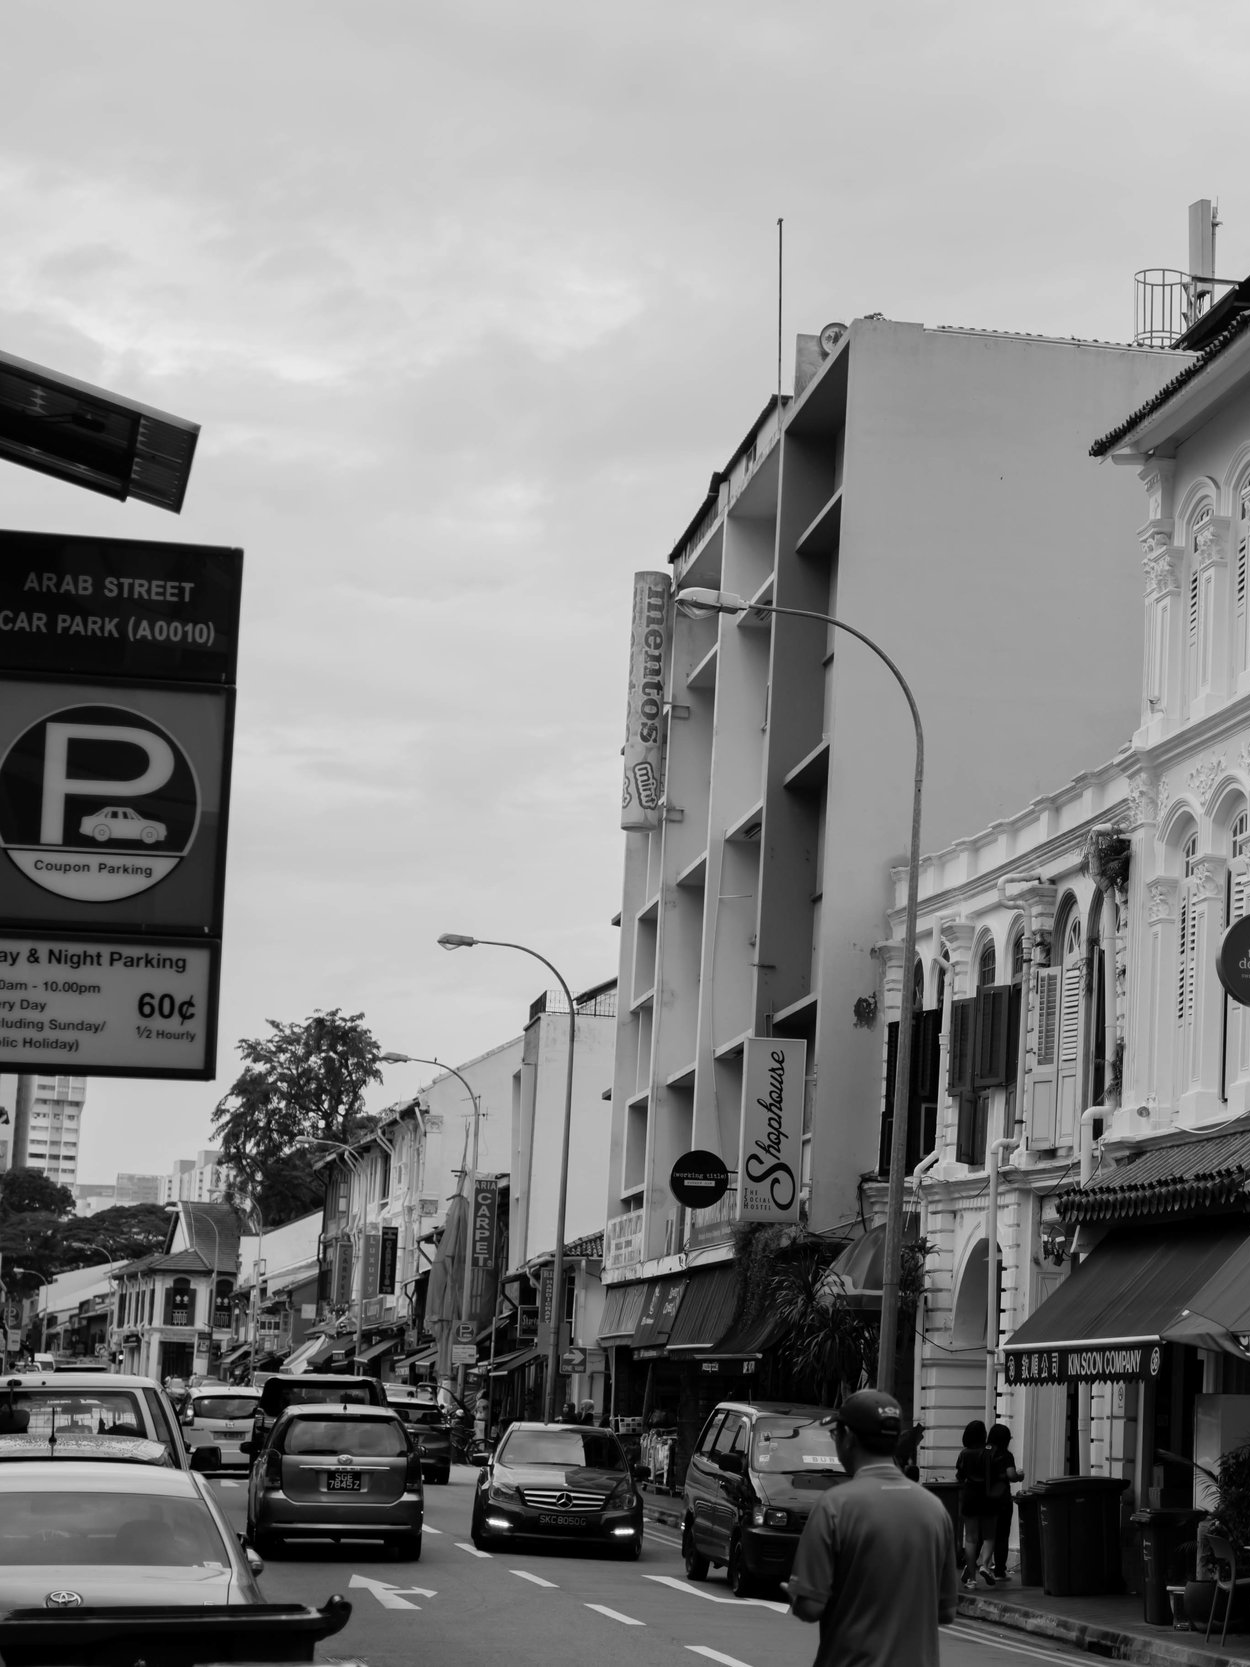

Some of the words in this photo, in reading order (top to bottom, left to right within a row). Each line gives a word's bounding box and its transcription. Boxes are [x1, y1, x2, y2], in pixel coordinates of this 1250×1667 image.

[24, 572, 93, 595] ARAB
[104, 577, 195, 602] STREET
[0, 610, 47, 633] CAR
[57, 614, 119, 638] PARK
[128, 616, 215, 646] (A0010)
[640, 586, 665, 744] mentos
[40, 722, 175, 844] P
[634, 763, 657, 809] mint
[34, 859, 91, 875] Coupon
[98, 862, 153, 878] Parking
[27, 948, 41, 964] &
[48, 949, 103, 969] Night
[109, 951, 187, 974] Parking
[43, 981, 101, 995] 10.00pm
[0, 1000, 16, 1012] ry
[20, 999, 47, 1013] Day
[138, 992, 196, 1026] 60¢
[0, 1017, 45, 1032] luding
[48, 1019, 107, 1034] Sunday/
[156, 1029, 196, 1043] Hourly
[0, 1037, 18, 1048] lic
[22, 1037, 79, 1052] Holiday)
[745, 1050, 796, 1211] Shophouse
[743, 1201, 771, 1210] HOSTEL
[744, 1195, 770, 1203] SOCIAL
[473, 1193, 492, 1267] CARPET
[1067, 1353, 1081, 1376] KIN
[1081, 1351, 1102, 1375] SOON
[1104, 1349, 1142, 1375] COMPANY
[335, 1473, 354, 1481] SGE
